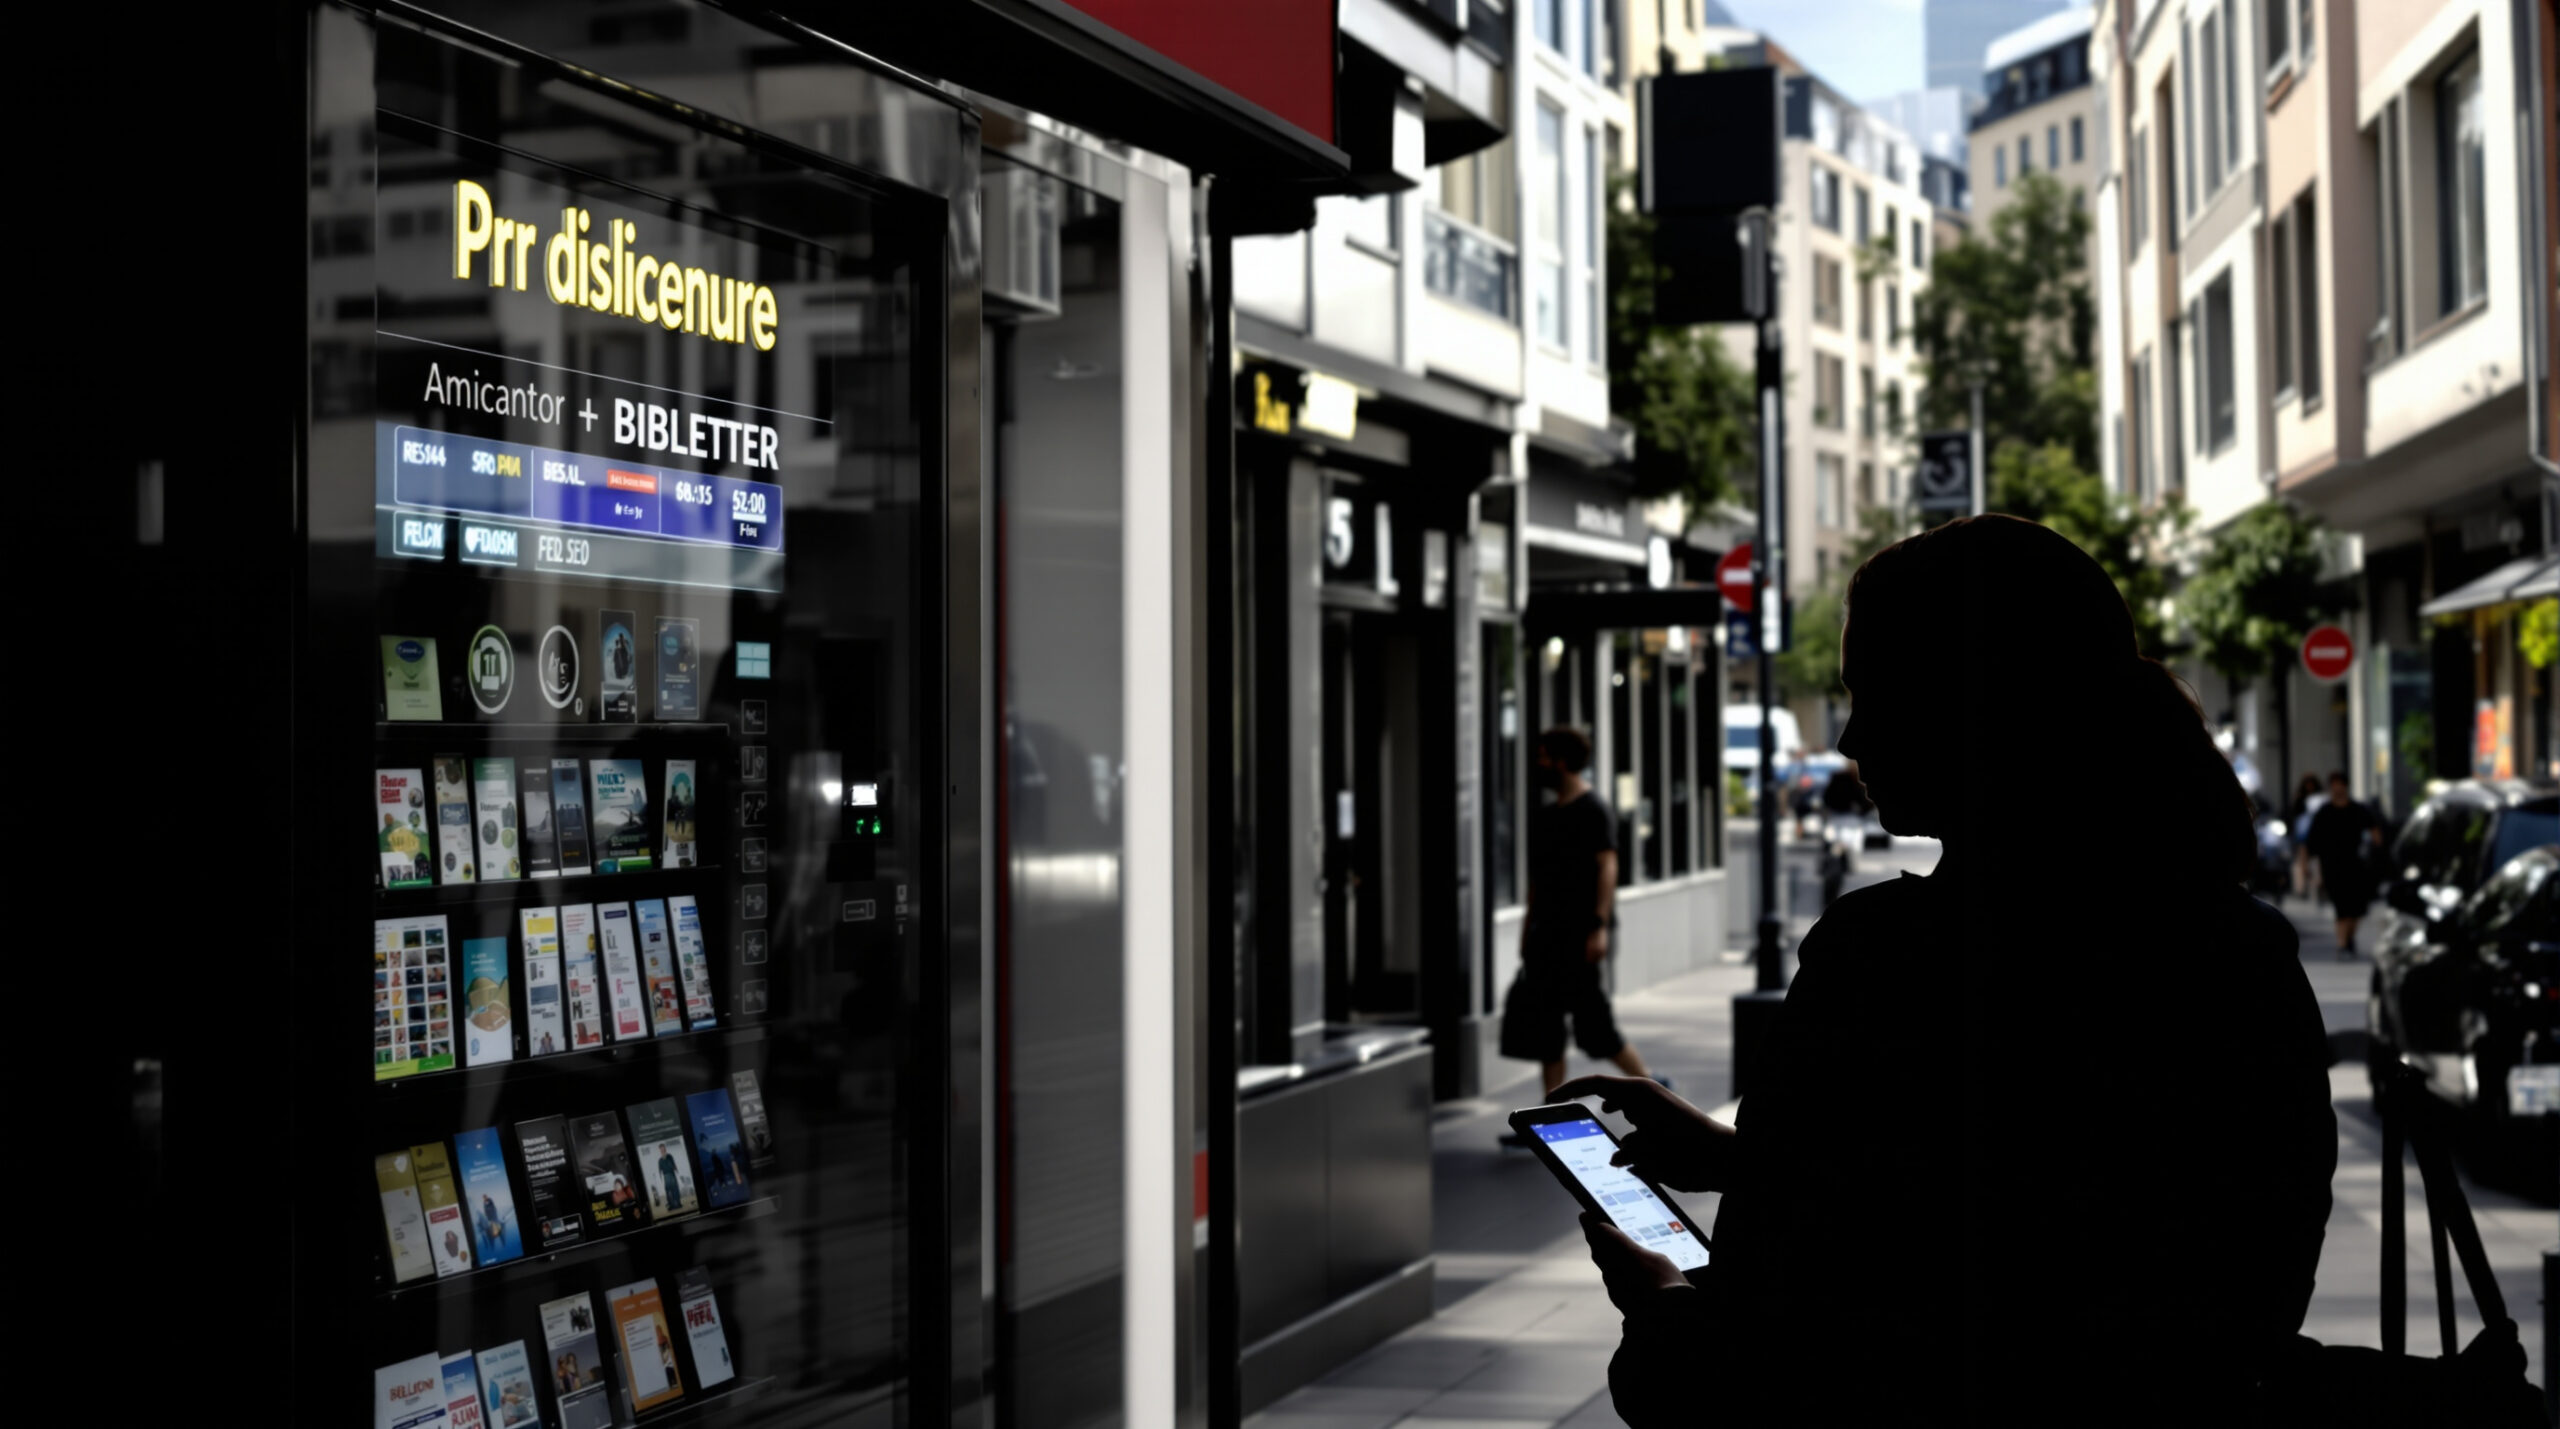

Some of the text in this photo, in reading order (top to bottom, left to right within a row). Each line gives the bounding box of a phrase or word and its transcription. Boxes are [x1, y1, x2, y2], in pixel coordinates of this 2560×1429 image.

[453, 179, 778, 351] Prr dislicenure
[424, 362, 779, 470] Amicantor + BIBLETTER
